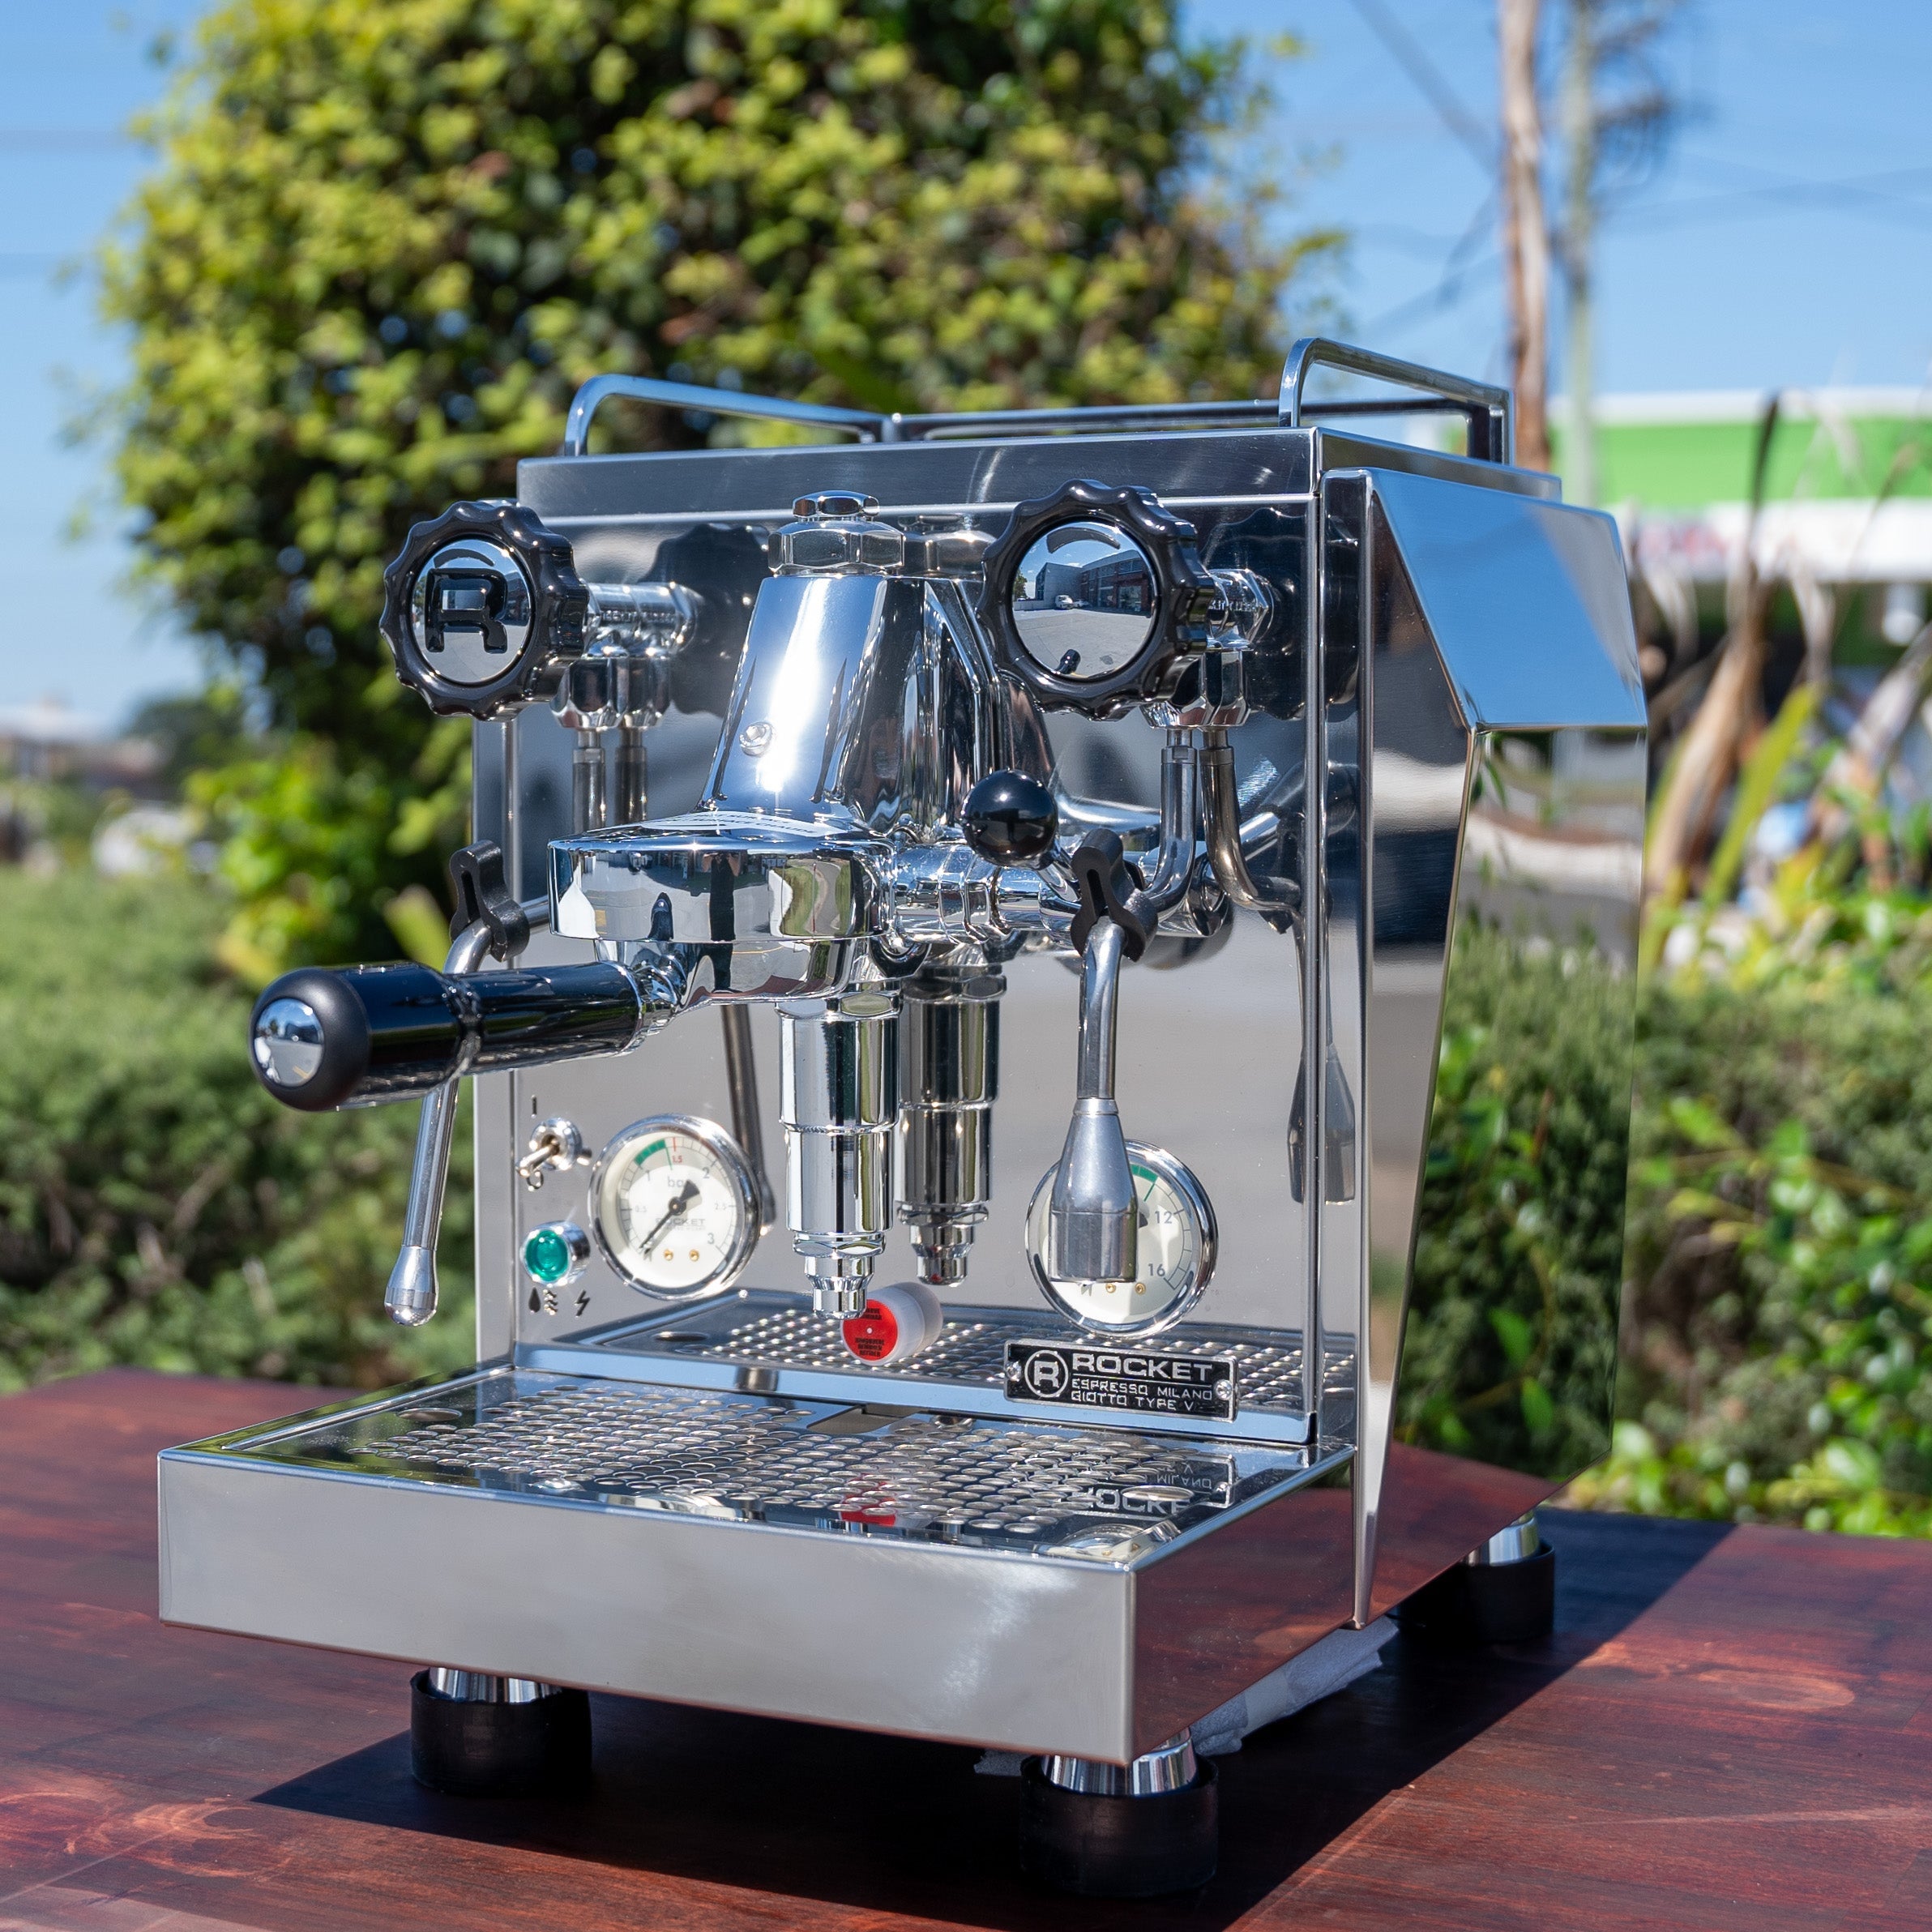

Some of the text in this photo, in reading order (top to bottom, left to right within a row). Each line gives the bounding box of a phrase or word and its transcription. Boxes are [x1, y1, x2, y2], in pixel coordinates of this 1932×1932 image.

[425, 568, 508, 654] R
[673, 1155, 683, 1164] 1.5
[645, 1169, 651, 1182] 1
[702, 1167, 710, 1179] 2
[667, 1176, 685, 1188] ba
[1155, 1211, 1173, 1225] 12
[707, 1233, 715, 1245] 3
[1148, 1263, 1165, 1277] 16
[1071, 1353, 1213, 1382] ROCKET
[1071, 1378, 1212, 1400] ESPRESSO MILANO
[1071, 1390, 1127, 1406] GIOTTO
[1135, 1396, 1177, 1411] TYPE
